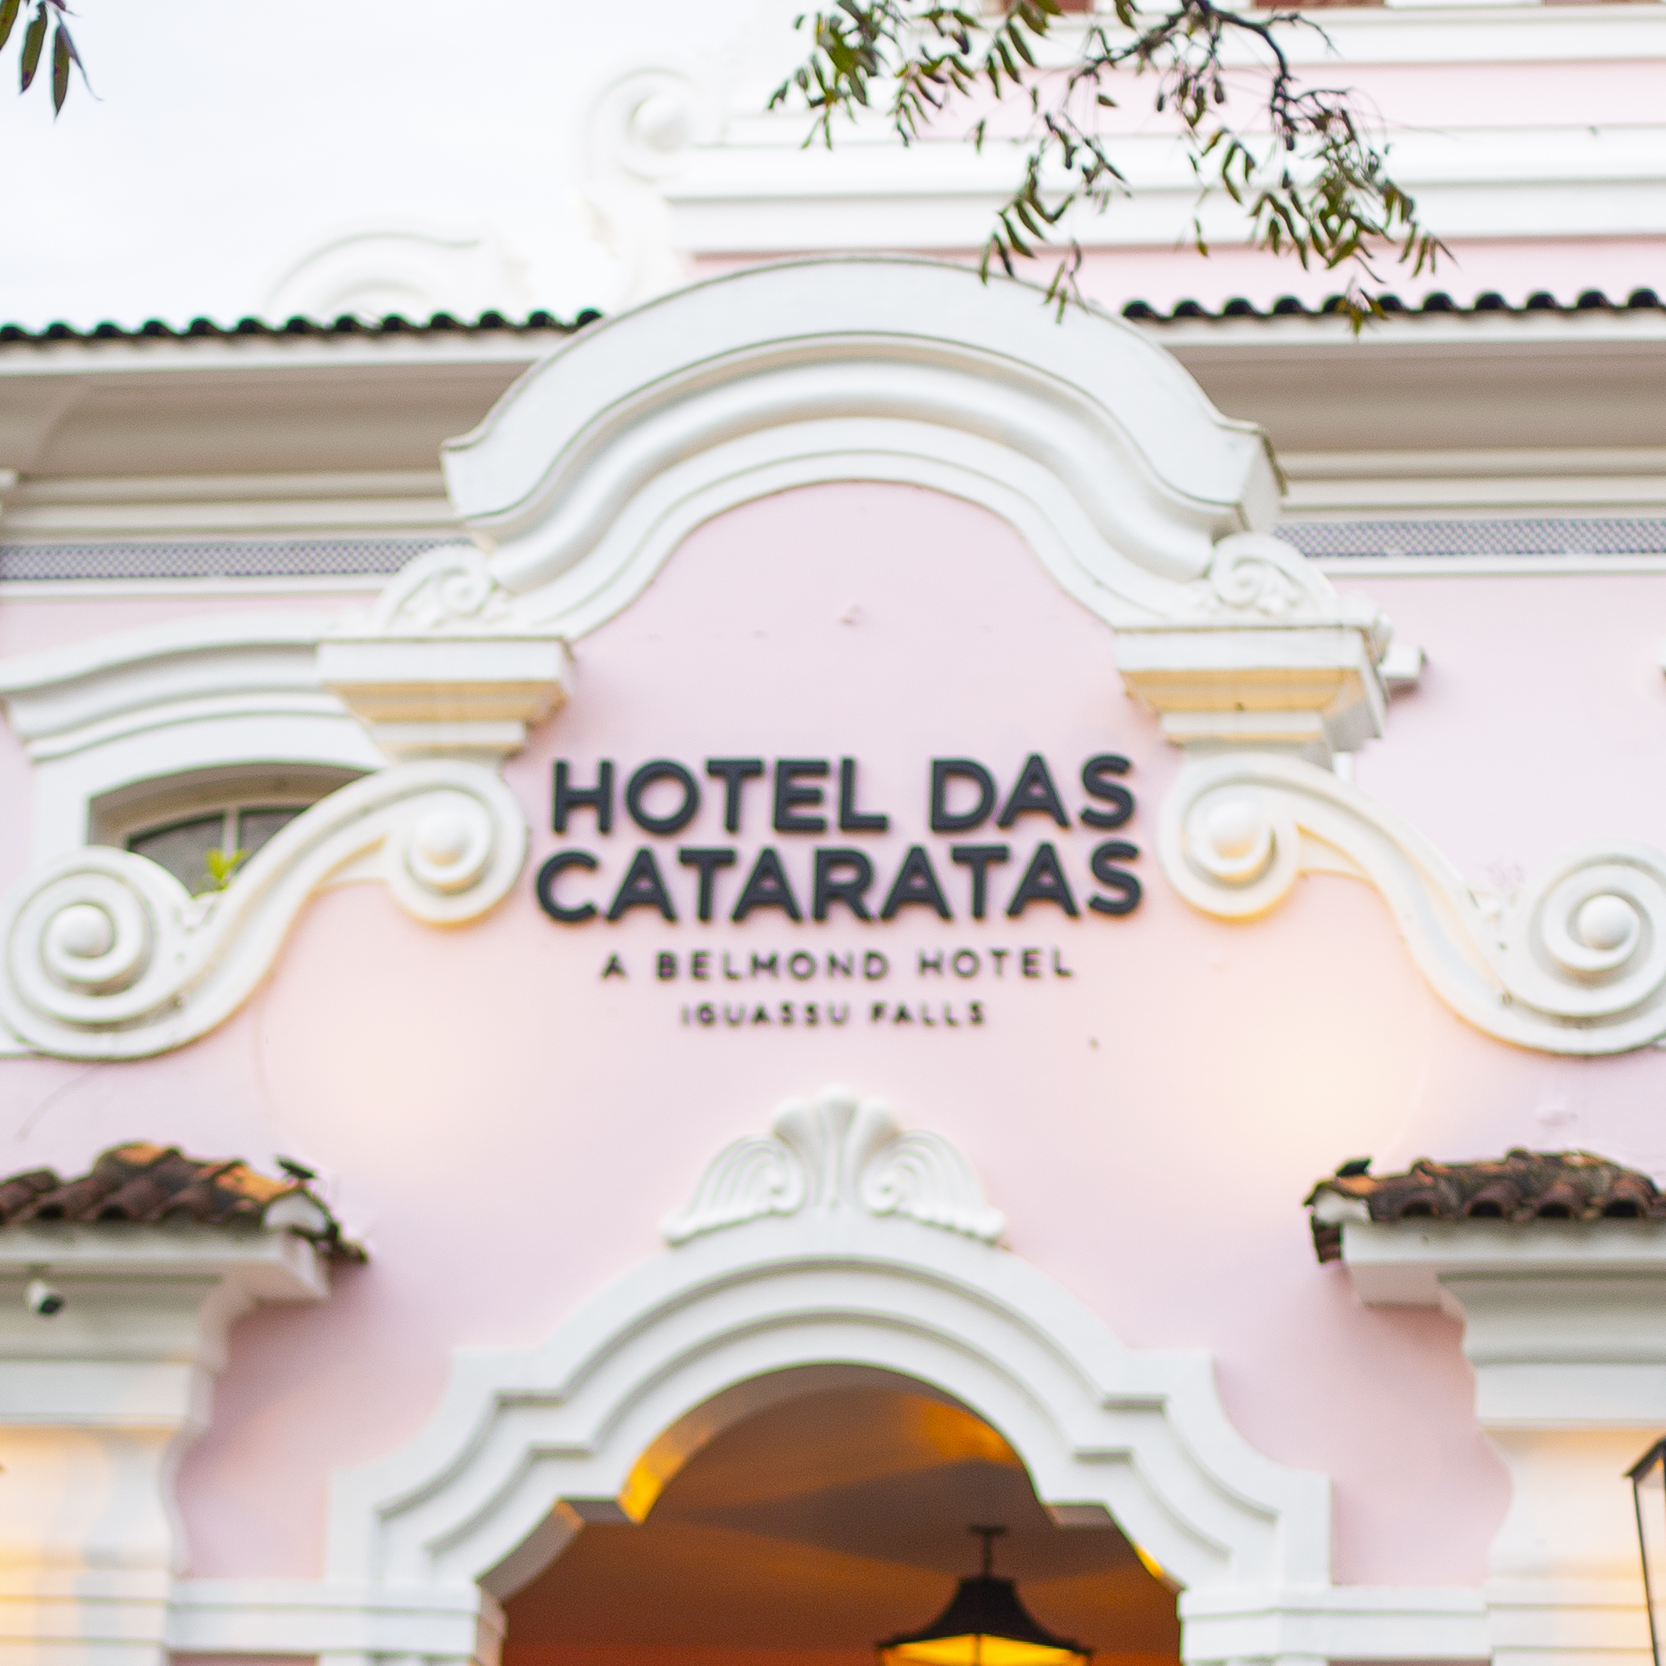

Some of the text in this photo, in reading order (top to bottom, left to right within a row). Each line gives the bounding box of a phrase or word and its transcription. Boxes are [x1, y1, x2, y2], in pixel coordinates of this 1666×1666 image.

[551, 753, 1137, 836] HOTEL DAS
[535, 841, 1144, 923] CATARATAS
[600, 948, 1074, 982] A BELMOND HOTEL
[682, 1002, 987, 1027] IGUASSU FALLS
